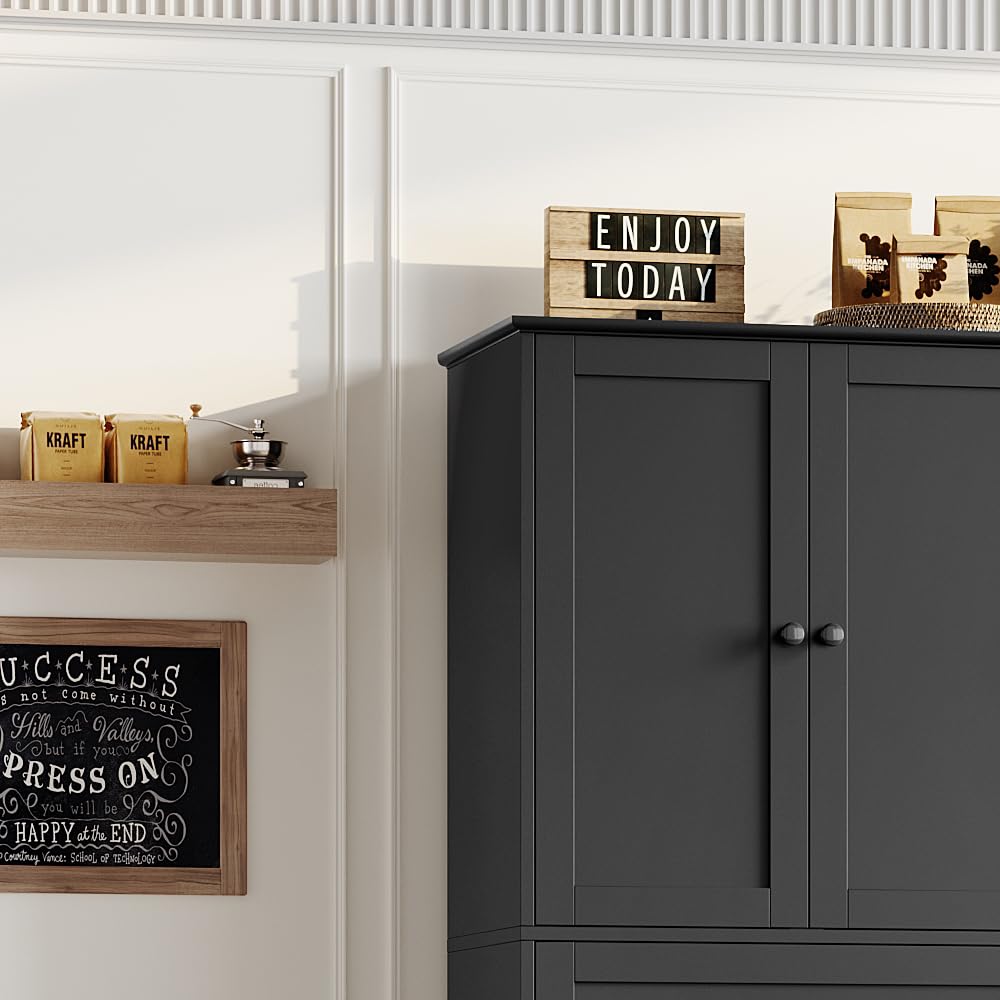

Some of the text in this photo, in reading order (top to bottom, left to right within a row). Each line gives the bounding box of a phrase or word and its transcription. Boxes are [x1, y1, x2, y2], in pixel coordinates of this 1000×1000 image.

[597, 214, 717, 254] ENJOY
[591, 262, 713, 302] TODAY
[46, 431, 87, 449] KRAFT
[130, 434, 171, 451] KRAFT
[20, 688, 47, 701] not
[62, 688, 97, 700] come
[109, 693, 175, 716] without
[11, 711, 154, 753] Hills and Valleys,
[44, 740, 117, 760] but if you
[2, 749, 159, 795] PRESS ON
[41, 799, 119, 817] you will be
[14, 821, 147, 844] HAPPY at the END
